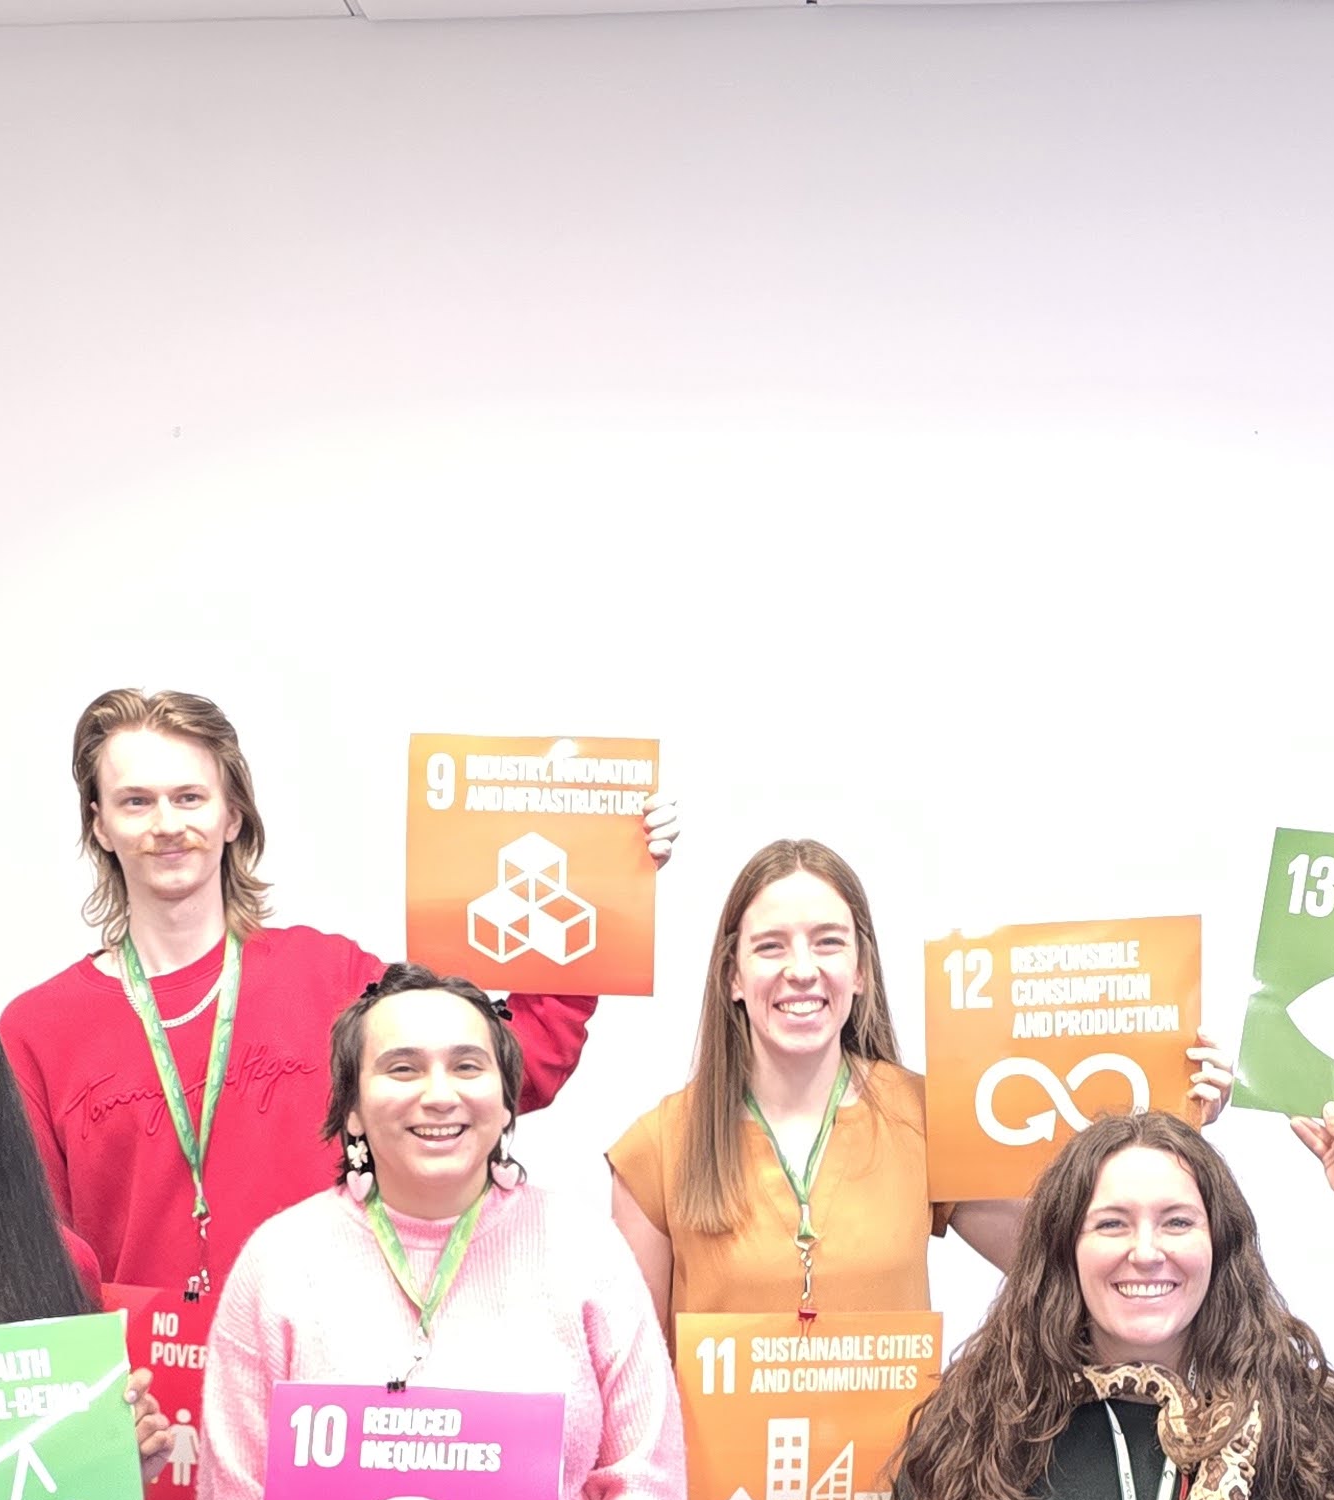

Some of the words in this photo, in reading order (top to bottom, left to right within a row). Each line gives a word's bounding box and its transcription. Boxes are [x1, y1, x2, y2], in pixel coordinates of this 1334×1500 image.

[426, 753, 455, 810] 9
[465, 785, 503, 811] AND
[1011, 941, 1140, 974] RESPONSIBLE
[943, 948, 993, 1009] 12
[1011, 973, 1151, 1007] CONSUMPTION
[1012, 1010, 1053, 1039] AND
[1053, 1005, 1179, 1037] PRODUCTION
[152, 1311, 179, 1337] NO
[151, 1341, 208, 1370] POVER
[750, 1335, 876, 1363] SUSTAINABLE
[876, 1333, 933, 1360] CITIES
[696, 1337, 736, 1395] 11
[750, 1368, 792, 1393] AND
[793, 1365, 918, 1392] COMMUNITIES
[290, 1405, 348, 1467] 10
[363, 1406, 462, 1436] REDUCED
[359, 1440, 502, 1472] INEQUALITIES
